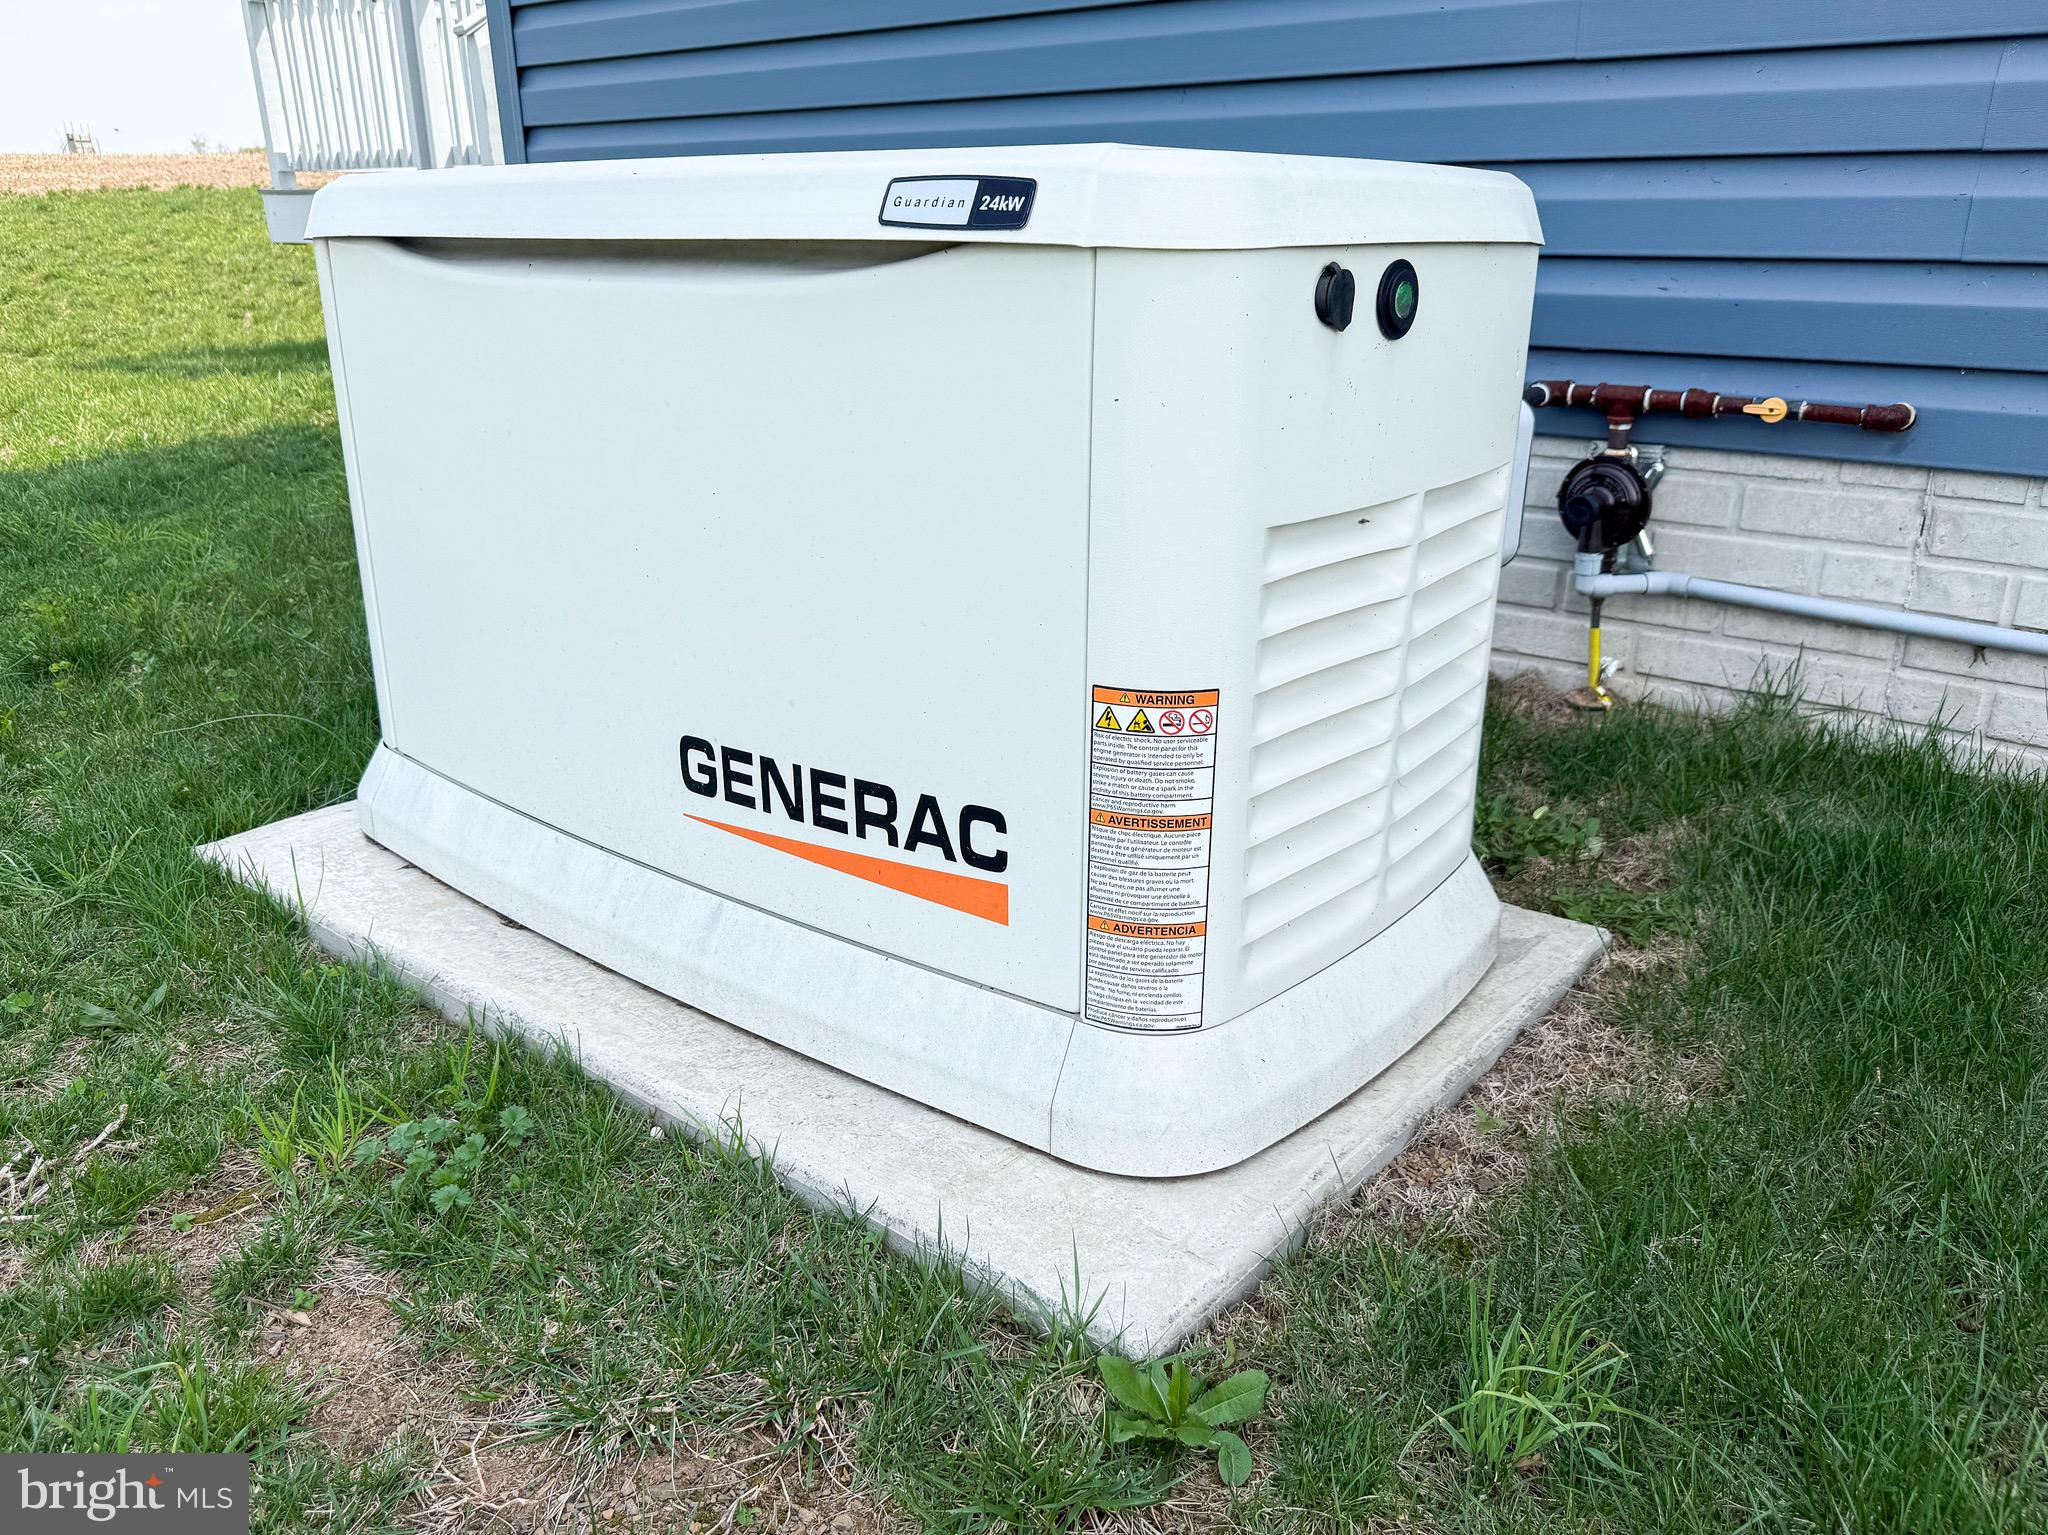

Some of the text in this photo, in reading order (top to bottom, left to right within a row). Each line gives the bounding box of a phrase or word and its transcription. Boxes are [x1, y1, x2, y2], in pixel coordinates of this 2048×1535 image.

[893, 195, 1025, 211] Guardian 24kW
[1135, 694, 1195, 705] WARNING
[679, 734, 1008, 873] GENERAC
[1108, 815, 1208, 829] AVERTISSEMENT
[1113, 923, 1197, 936] ADVERTENCIA
